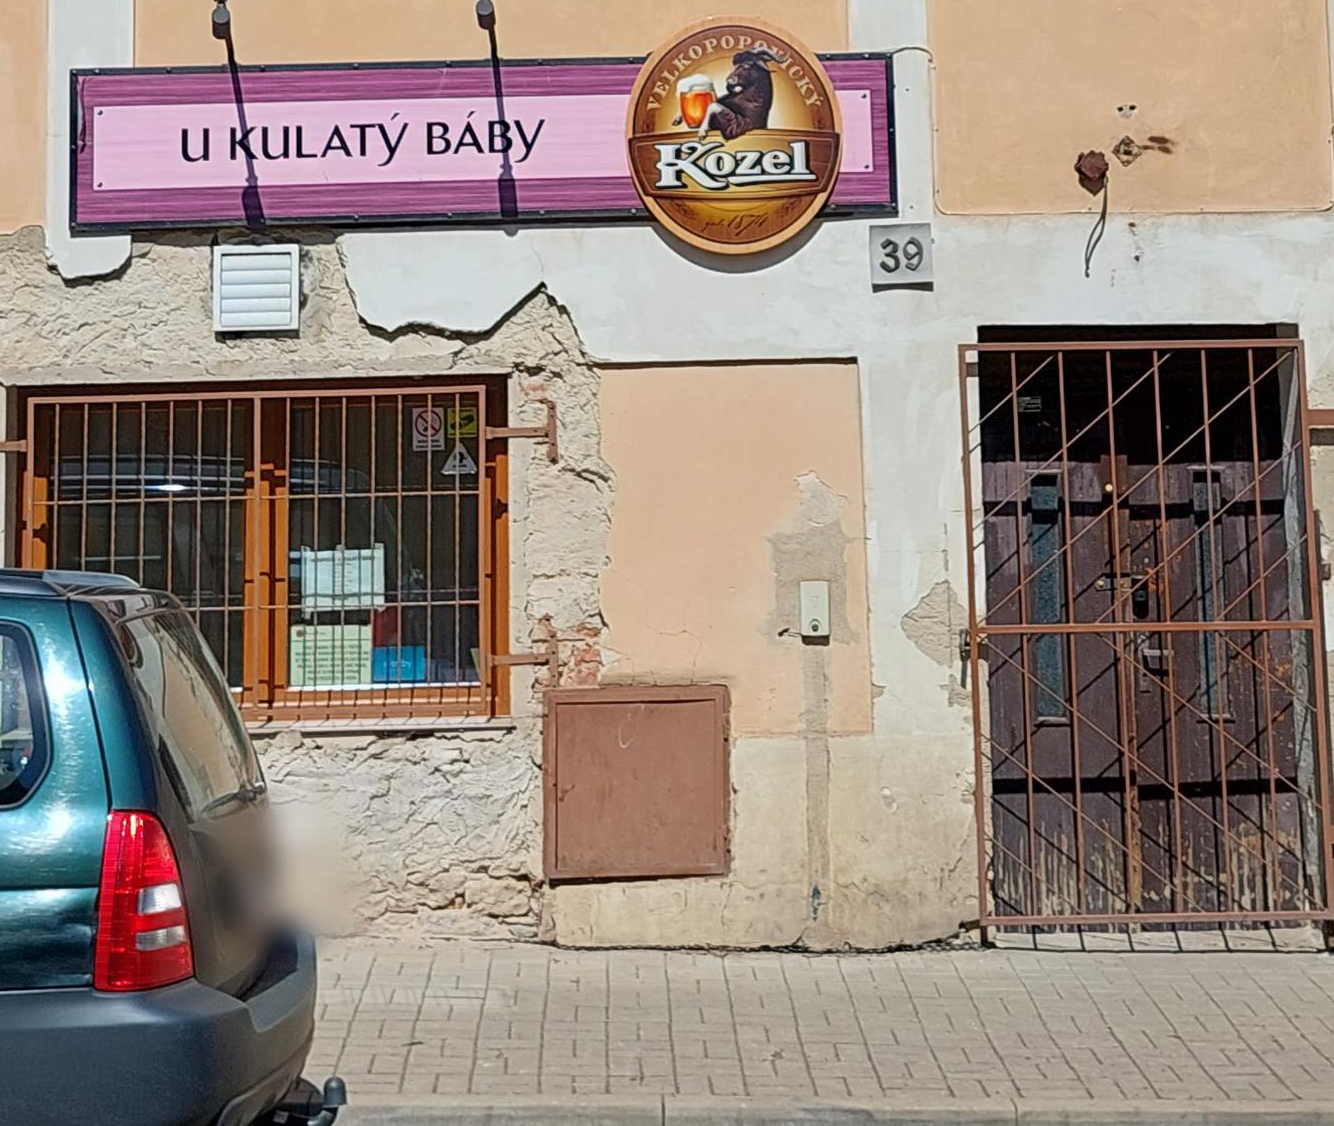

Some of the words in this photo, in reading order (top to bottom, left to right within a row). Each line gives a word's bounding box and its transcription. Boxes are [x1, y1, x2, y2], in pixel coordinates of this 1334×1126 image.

[180, 127, 211, 163] U
[229, 112, 410, 167] KULATÝ
[425, 110, 546, 164] BÁBY
[654, 140, 818, 191] Kozel
[879, 236, 924, 273] 39
